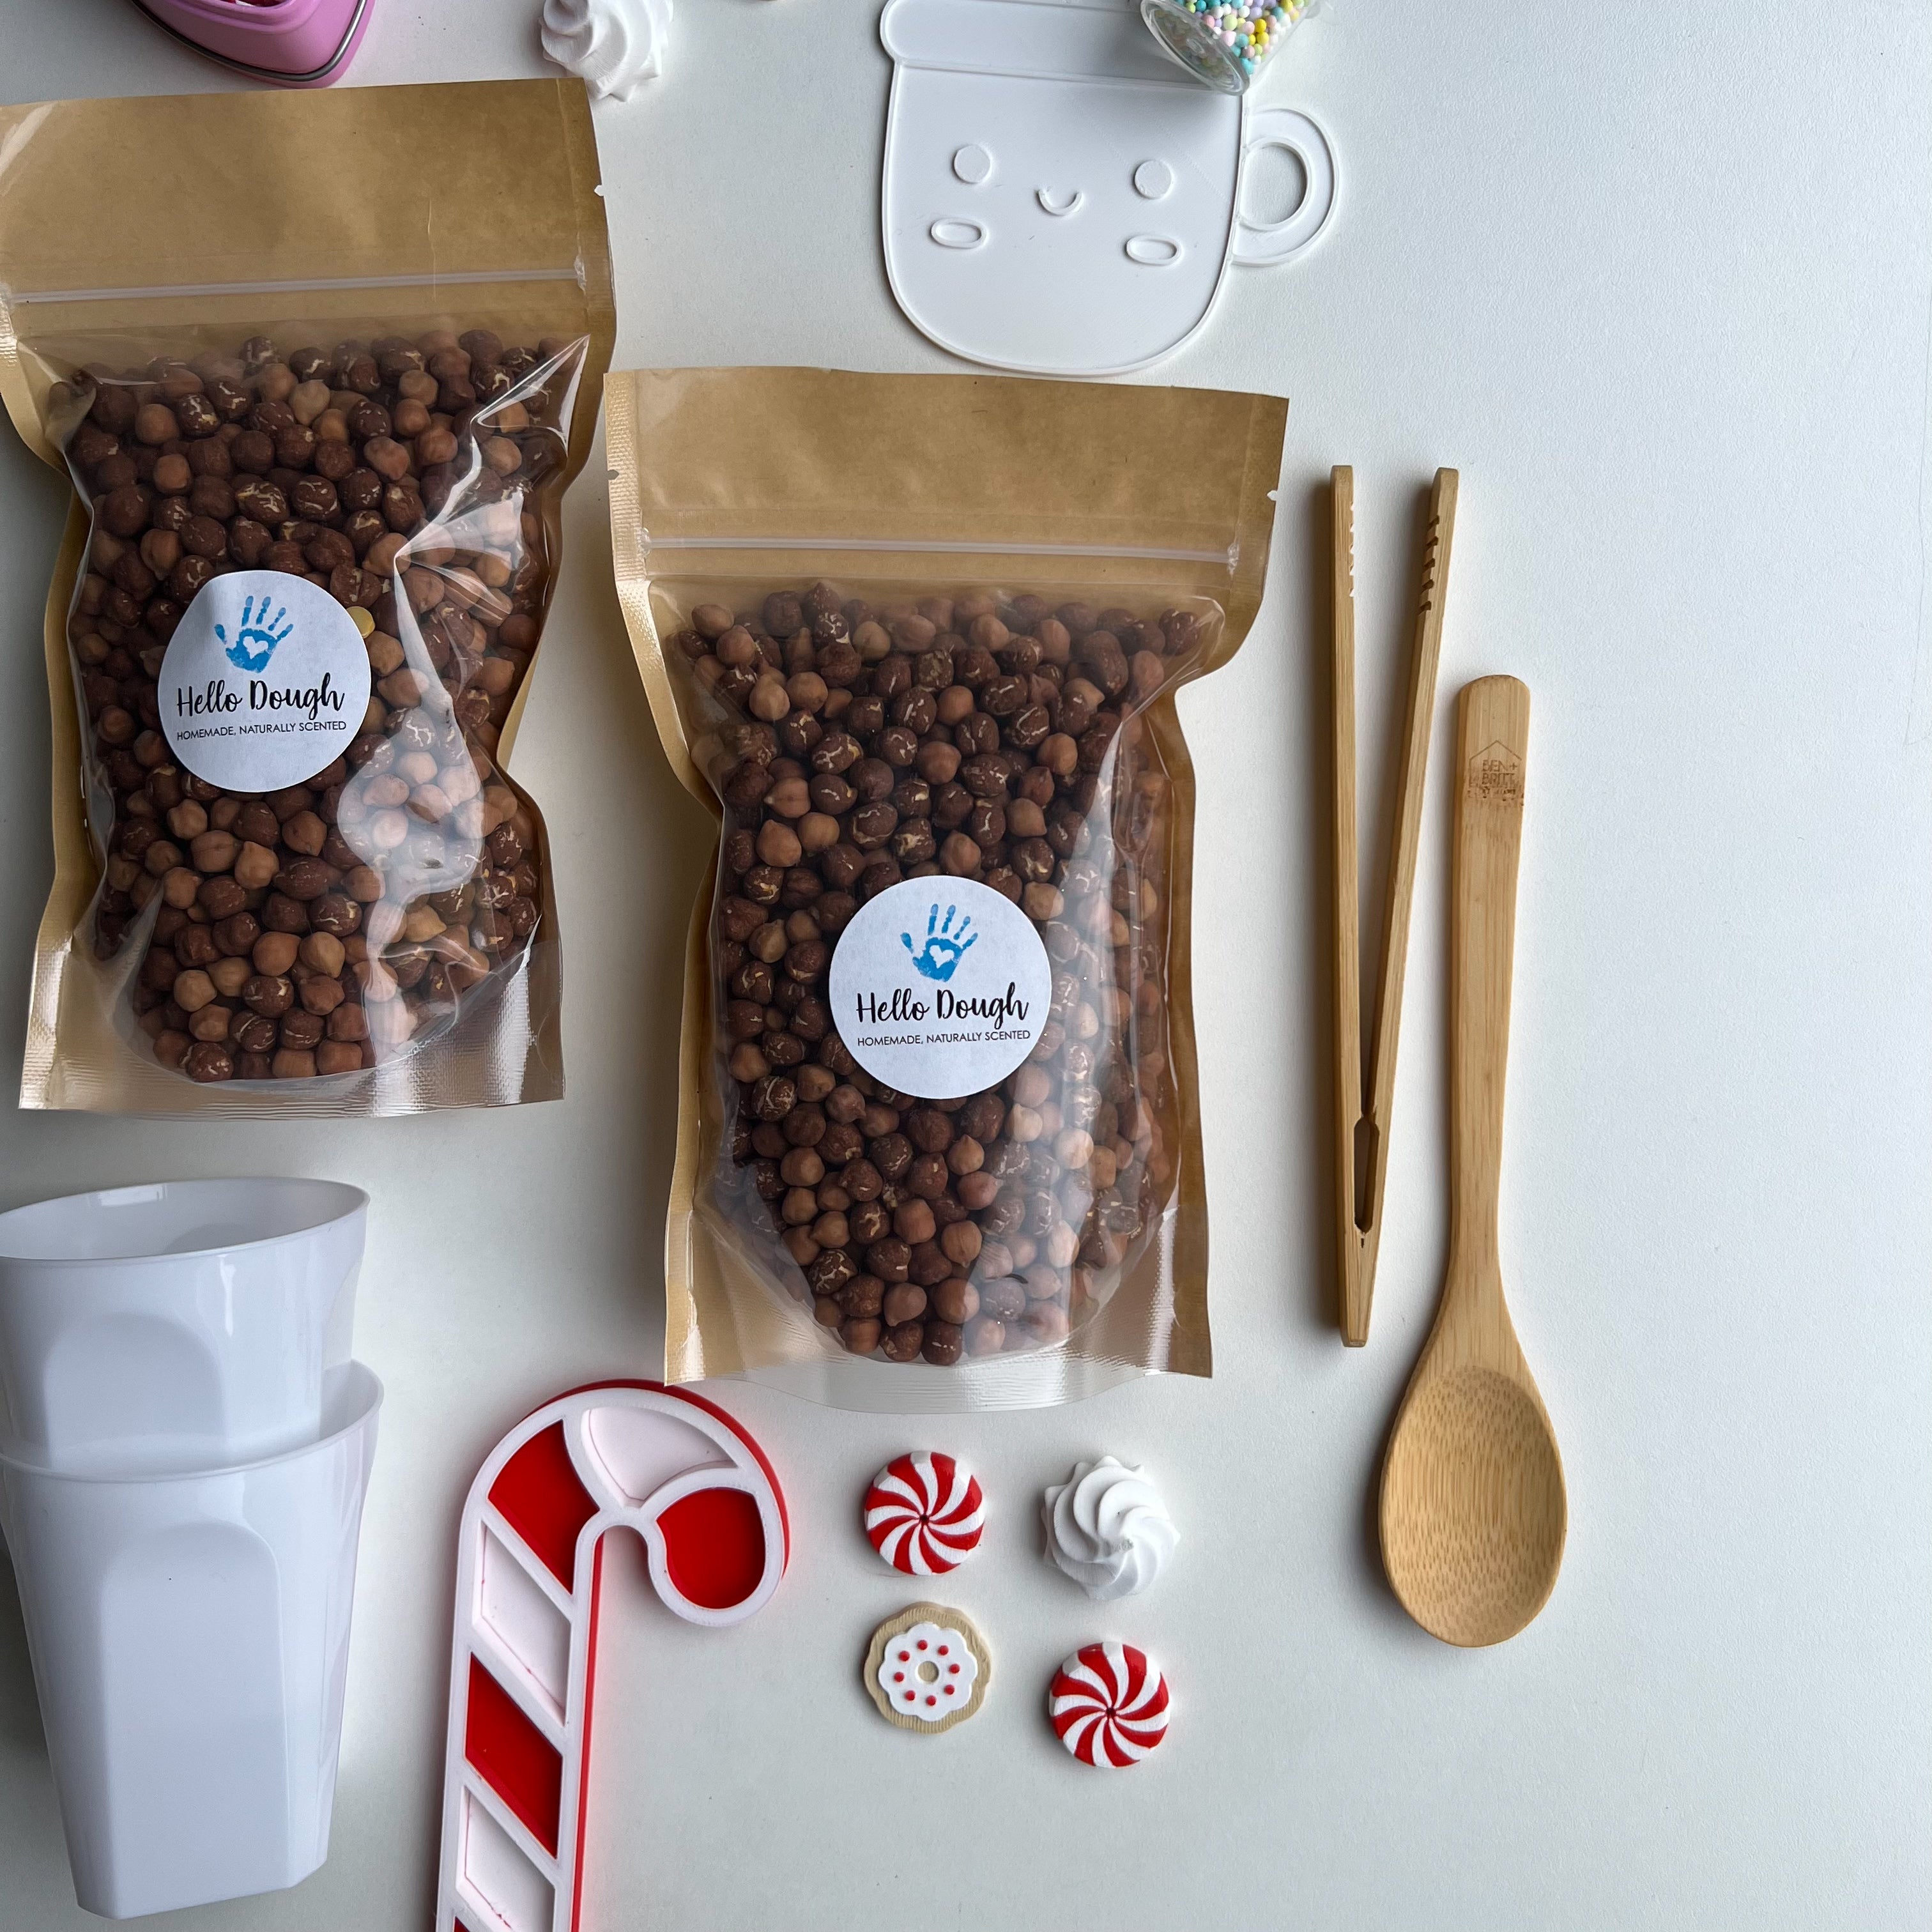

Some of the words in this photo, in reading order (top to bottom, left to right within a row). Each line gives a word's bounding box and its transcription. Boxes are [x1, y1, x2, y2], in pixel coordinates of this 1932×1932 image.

[176, 679, 243, 717] Hello
[250, 671, 346, 721] Dough
[176, 726, 236, 741] HOMEMADE,
[239, 723, 296, 735] NATURALLY
[298, 721, 347, 732] SCENTED
[855, 988, 931, 1023] Hello
[936, 981, 1030, 1031] Dough
[857, 1034, 924, 1046] HOMEMADE,
[926, 1032, 982, 1043] NATURALLY
[985, 1030, 1031, 1041] SCENTED
